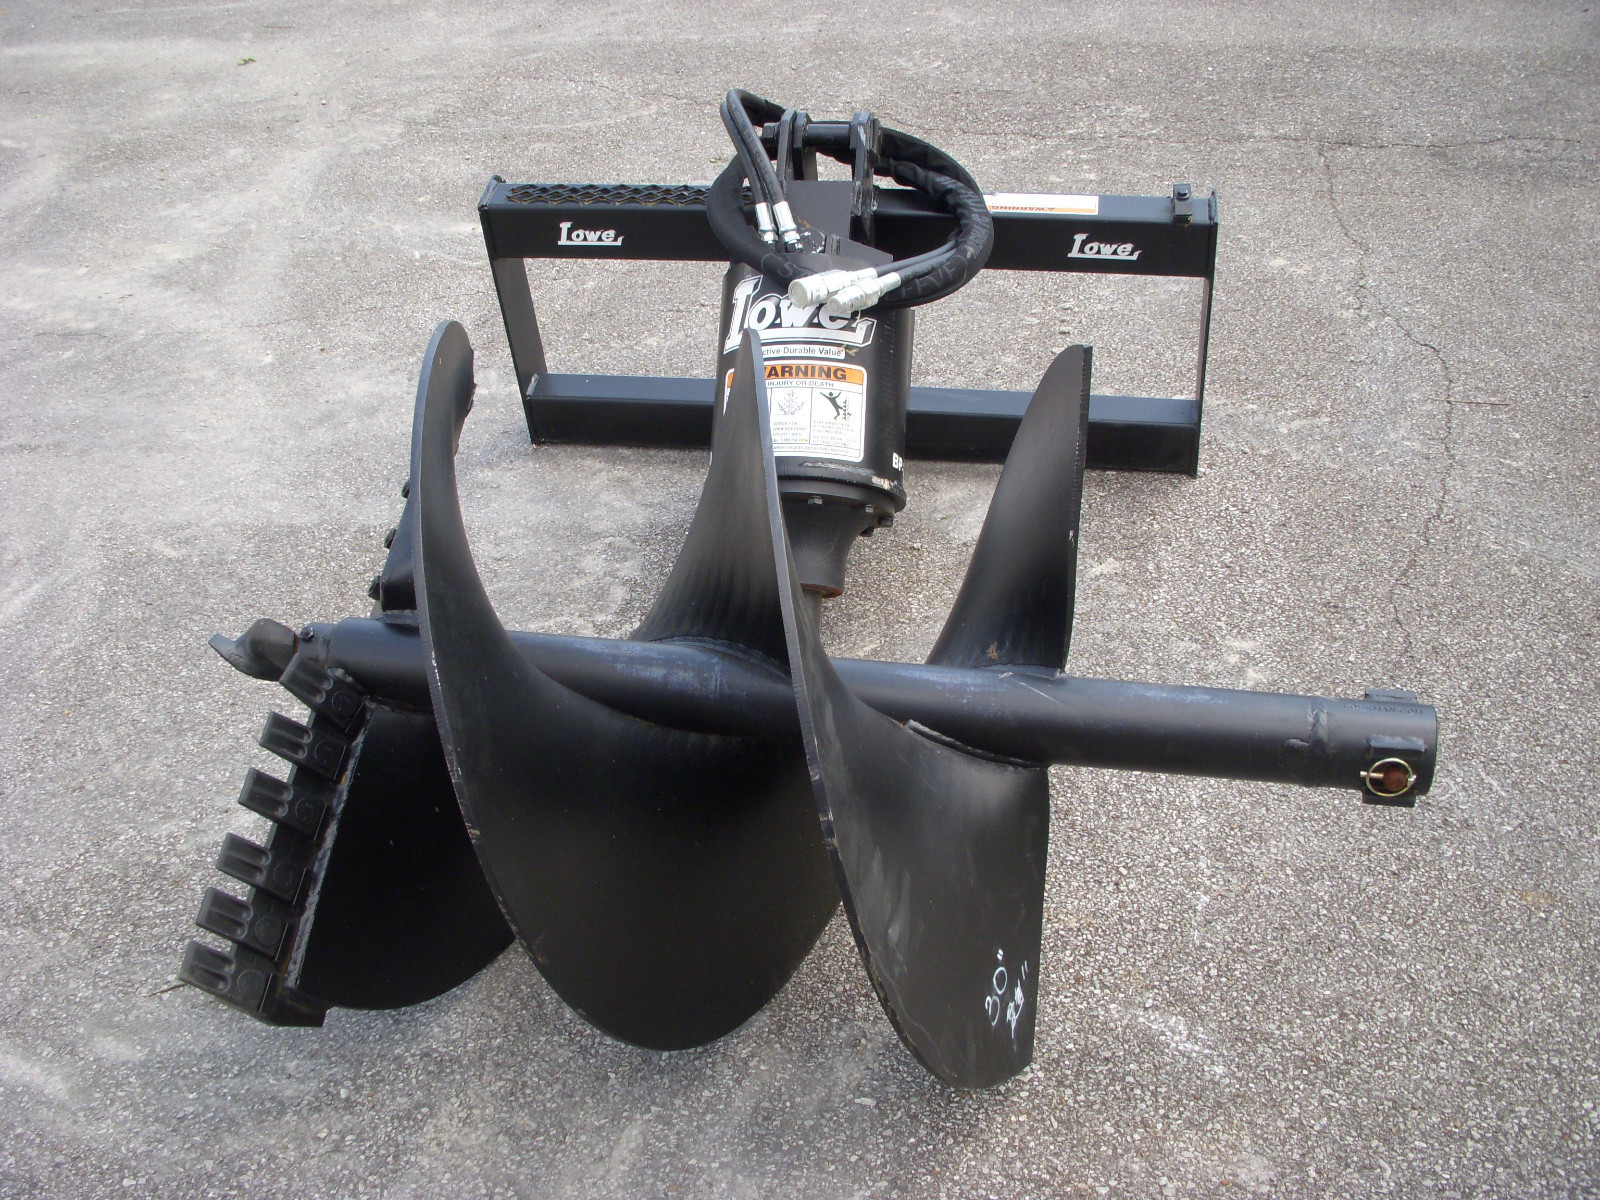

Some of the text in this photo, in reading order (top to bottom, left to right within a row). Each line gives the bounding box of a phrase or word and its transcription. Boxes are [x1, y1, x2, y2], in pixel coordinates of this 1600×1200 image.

[557, 221, 625, 246] Lowe
[1067, 233, 1143, 261] Lowe
[761, 347, 781, 356] ctive
[783, 346, 816, 355] Durable
[764, 365, 847, 380] ARNING
